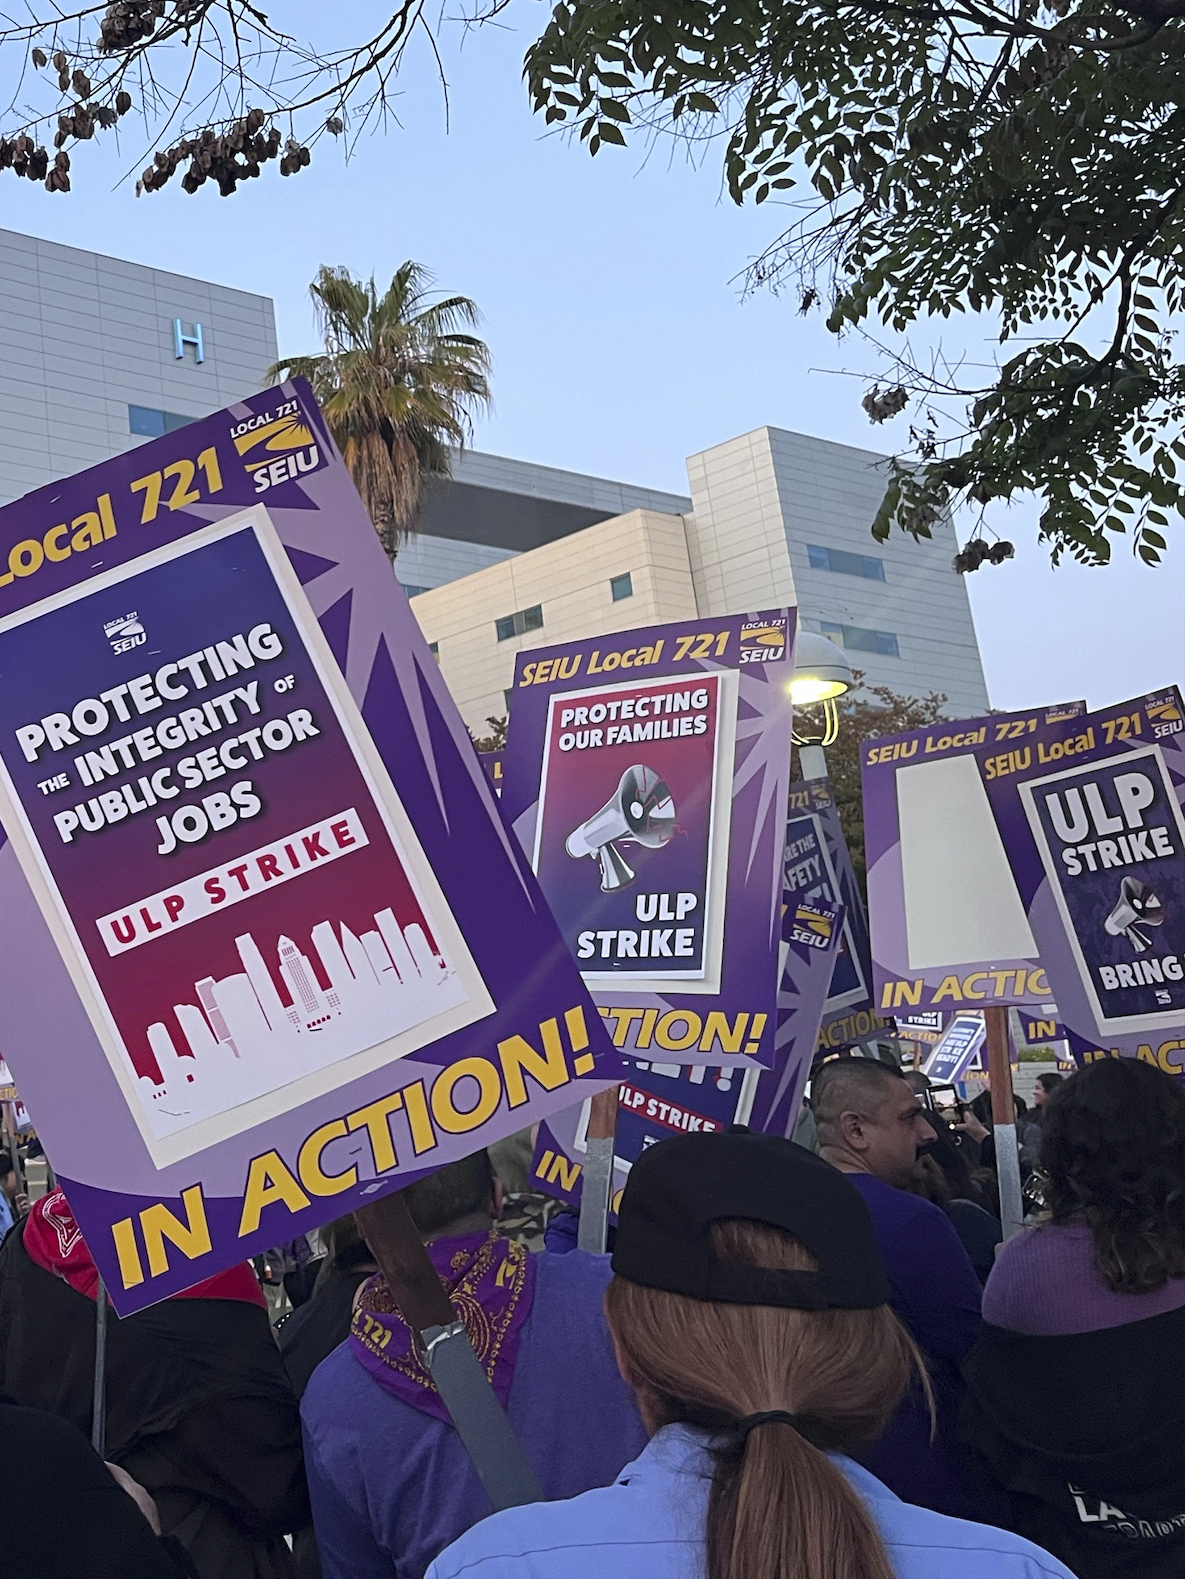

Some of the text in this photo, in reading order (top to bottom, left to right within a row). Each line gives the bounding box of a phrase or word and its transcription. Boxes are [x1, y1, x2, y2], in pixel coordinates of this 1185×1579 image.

[172, 317, 204, 364] H
[230, 399, 298, 439] LOCAL 721
[130, 445, 224, 526] 721
[254, 444, 319, 493] SEIU
[114, 632, 147, 656] SEIU
[740, 618, 786, 631] LOCAL 721
[518, 631, 730, 688] SEIU Local 721
[739, 646, 784, 664] SEIU
[15, 623, 284, 763] PROTECTING
[560, 688, 709, 729] PROTECTING
[1145, 700, 1164, 710] LOCAL
[37, 674, 295, 796] THE INTEGRITY OF
[558, 714, 709, 752] OUR FAMILIES
[866, 718, 1038, 767] SEIU Local 721
[984, 711, 1143, 781] SEIU Local 721
[1154, 720, 1183, 739] SEIU
[53, 708, 320, 844] PUBLIC SECTOR
[155, 780, 262, 855] JOBS
[789, 791, 810, 810] 721
[1045, 771, 1155, 844] ULP
[796, 833, 816, 854] THE
[1061, 826, 1175, 876] STRIKE
[110, 819, 356, 945] ULP STRIKE
[783, 854, 822, 892] AFETY
[635, 892, 699, 922] ULP
[797, 904, 836, 919] LOCAL 721
[576, 928, 696, 959] STRIKE
[790, 929, 830, 949] SEIU
[880, 968, 1052, 1010] IN ACTIO
[1098, 955, 1184, 992] BRING
[597, 1005, 769, 1055] TION!
[898, 1030, 942, 1042] ACTIO
[1028, 1020, 1056, 1040] IN
[111, 1005, 595, 1290] IN ACTION!
[534, 1150, 582, 1192] IN
[364, 1315, 393, 1349] 721
